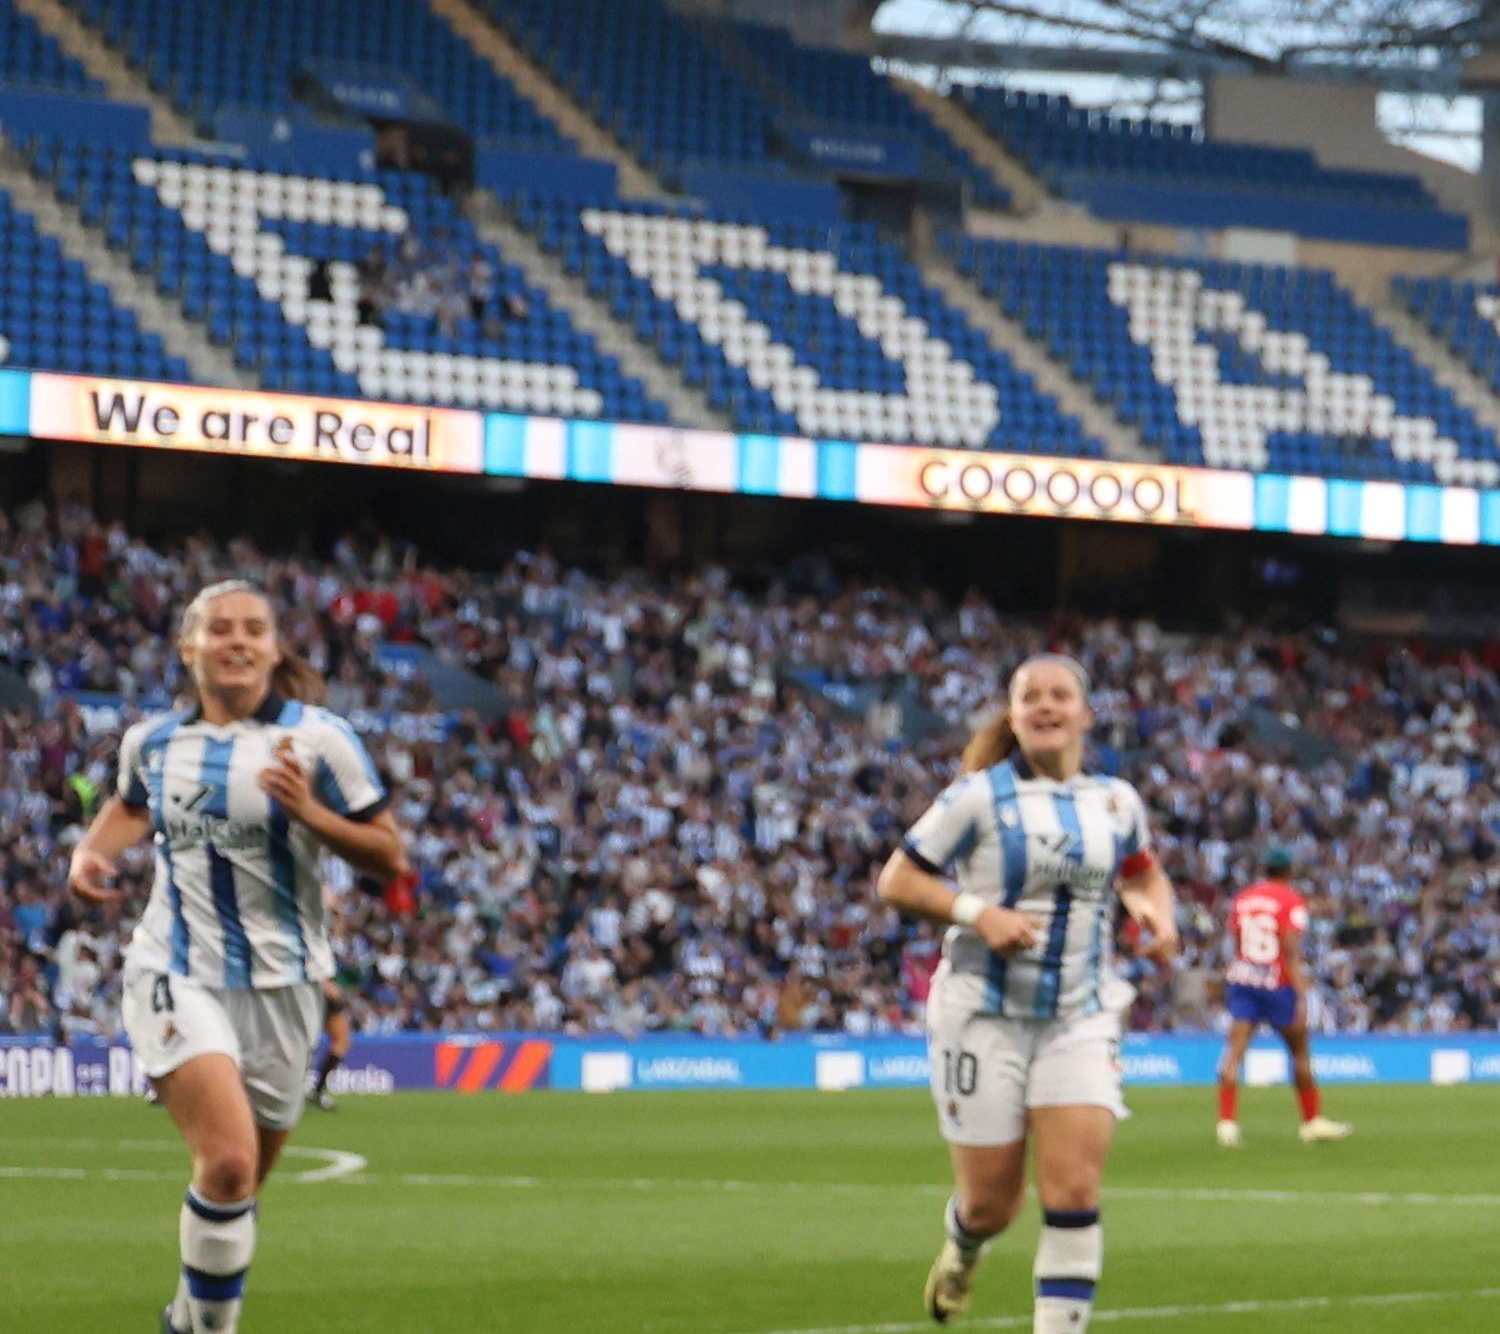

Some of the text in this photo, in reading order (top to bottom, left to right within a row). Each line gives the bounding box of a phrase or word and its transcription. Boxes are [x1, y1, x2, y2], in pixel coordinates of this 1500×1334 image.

[93, 391, 431, 457] We are Real
[942, 1050, 978, 1096] 10
